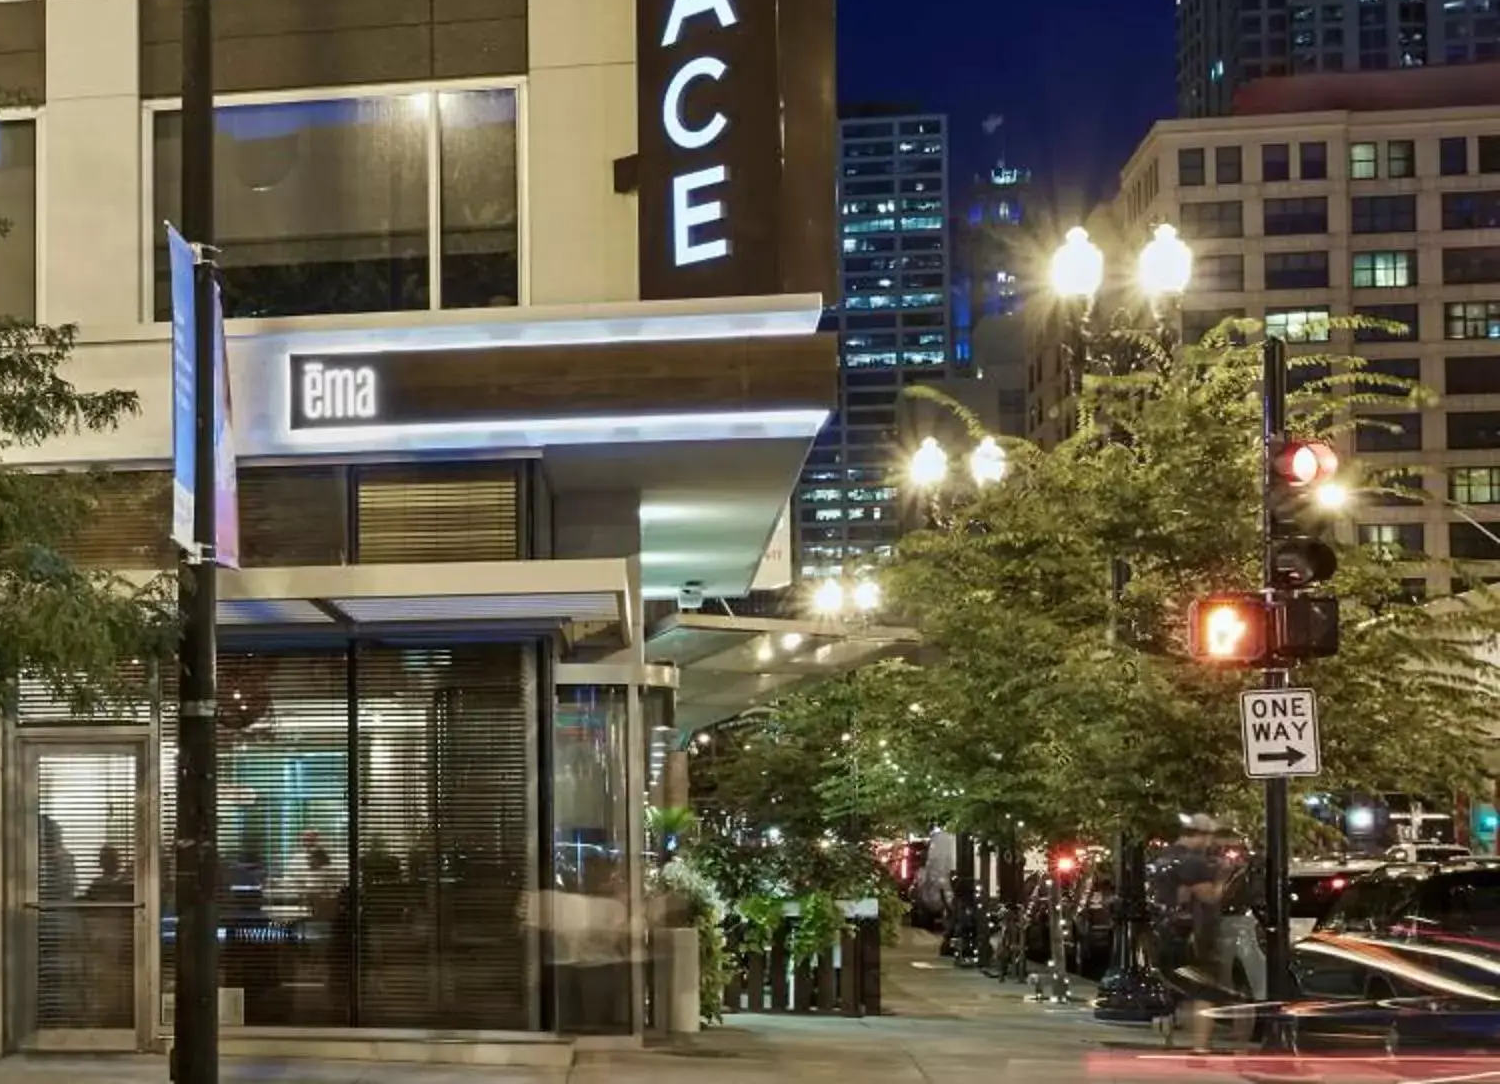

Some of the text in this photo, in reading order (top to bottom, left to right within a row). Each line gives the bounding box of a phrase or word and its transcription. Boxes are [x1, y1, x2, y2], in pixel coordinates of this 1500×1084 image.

[303, 362, 376, 419] ēma
[1251, 697, 1306, 718] ONE
[1252, 720, 1308, 742] WAY
